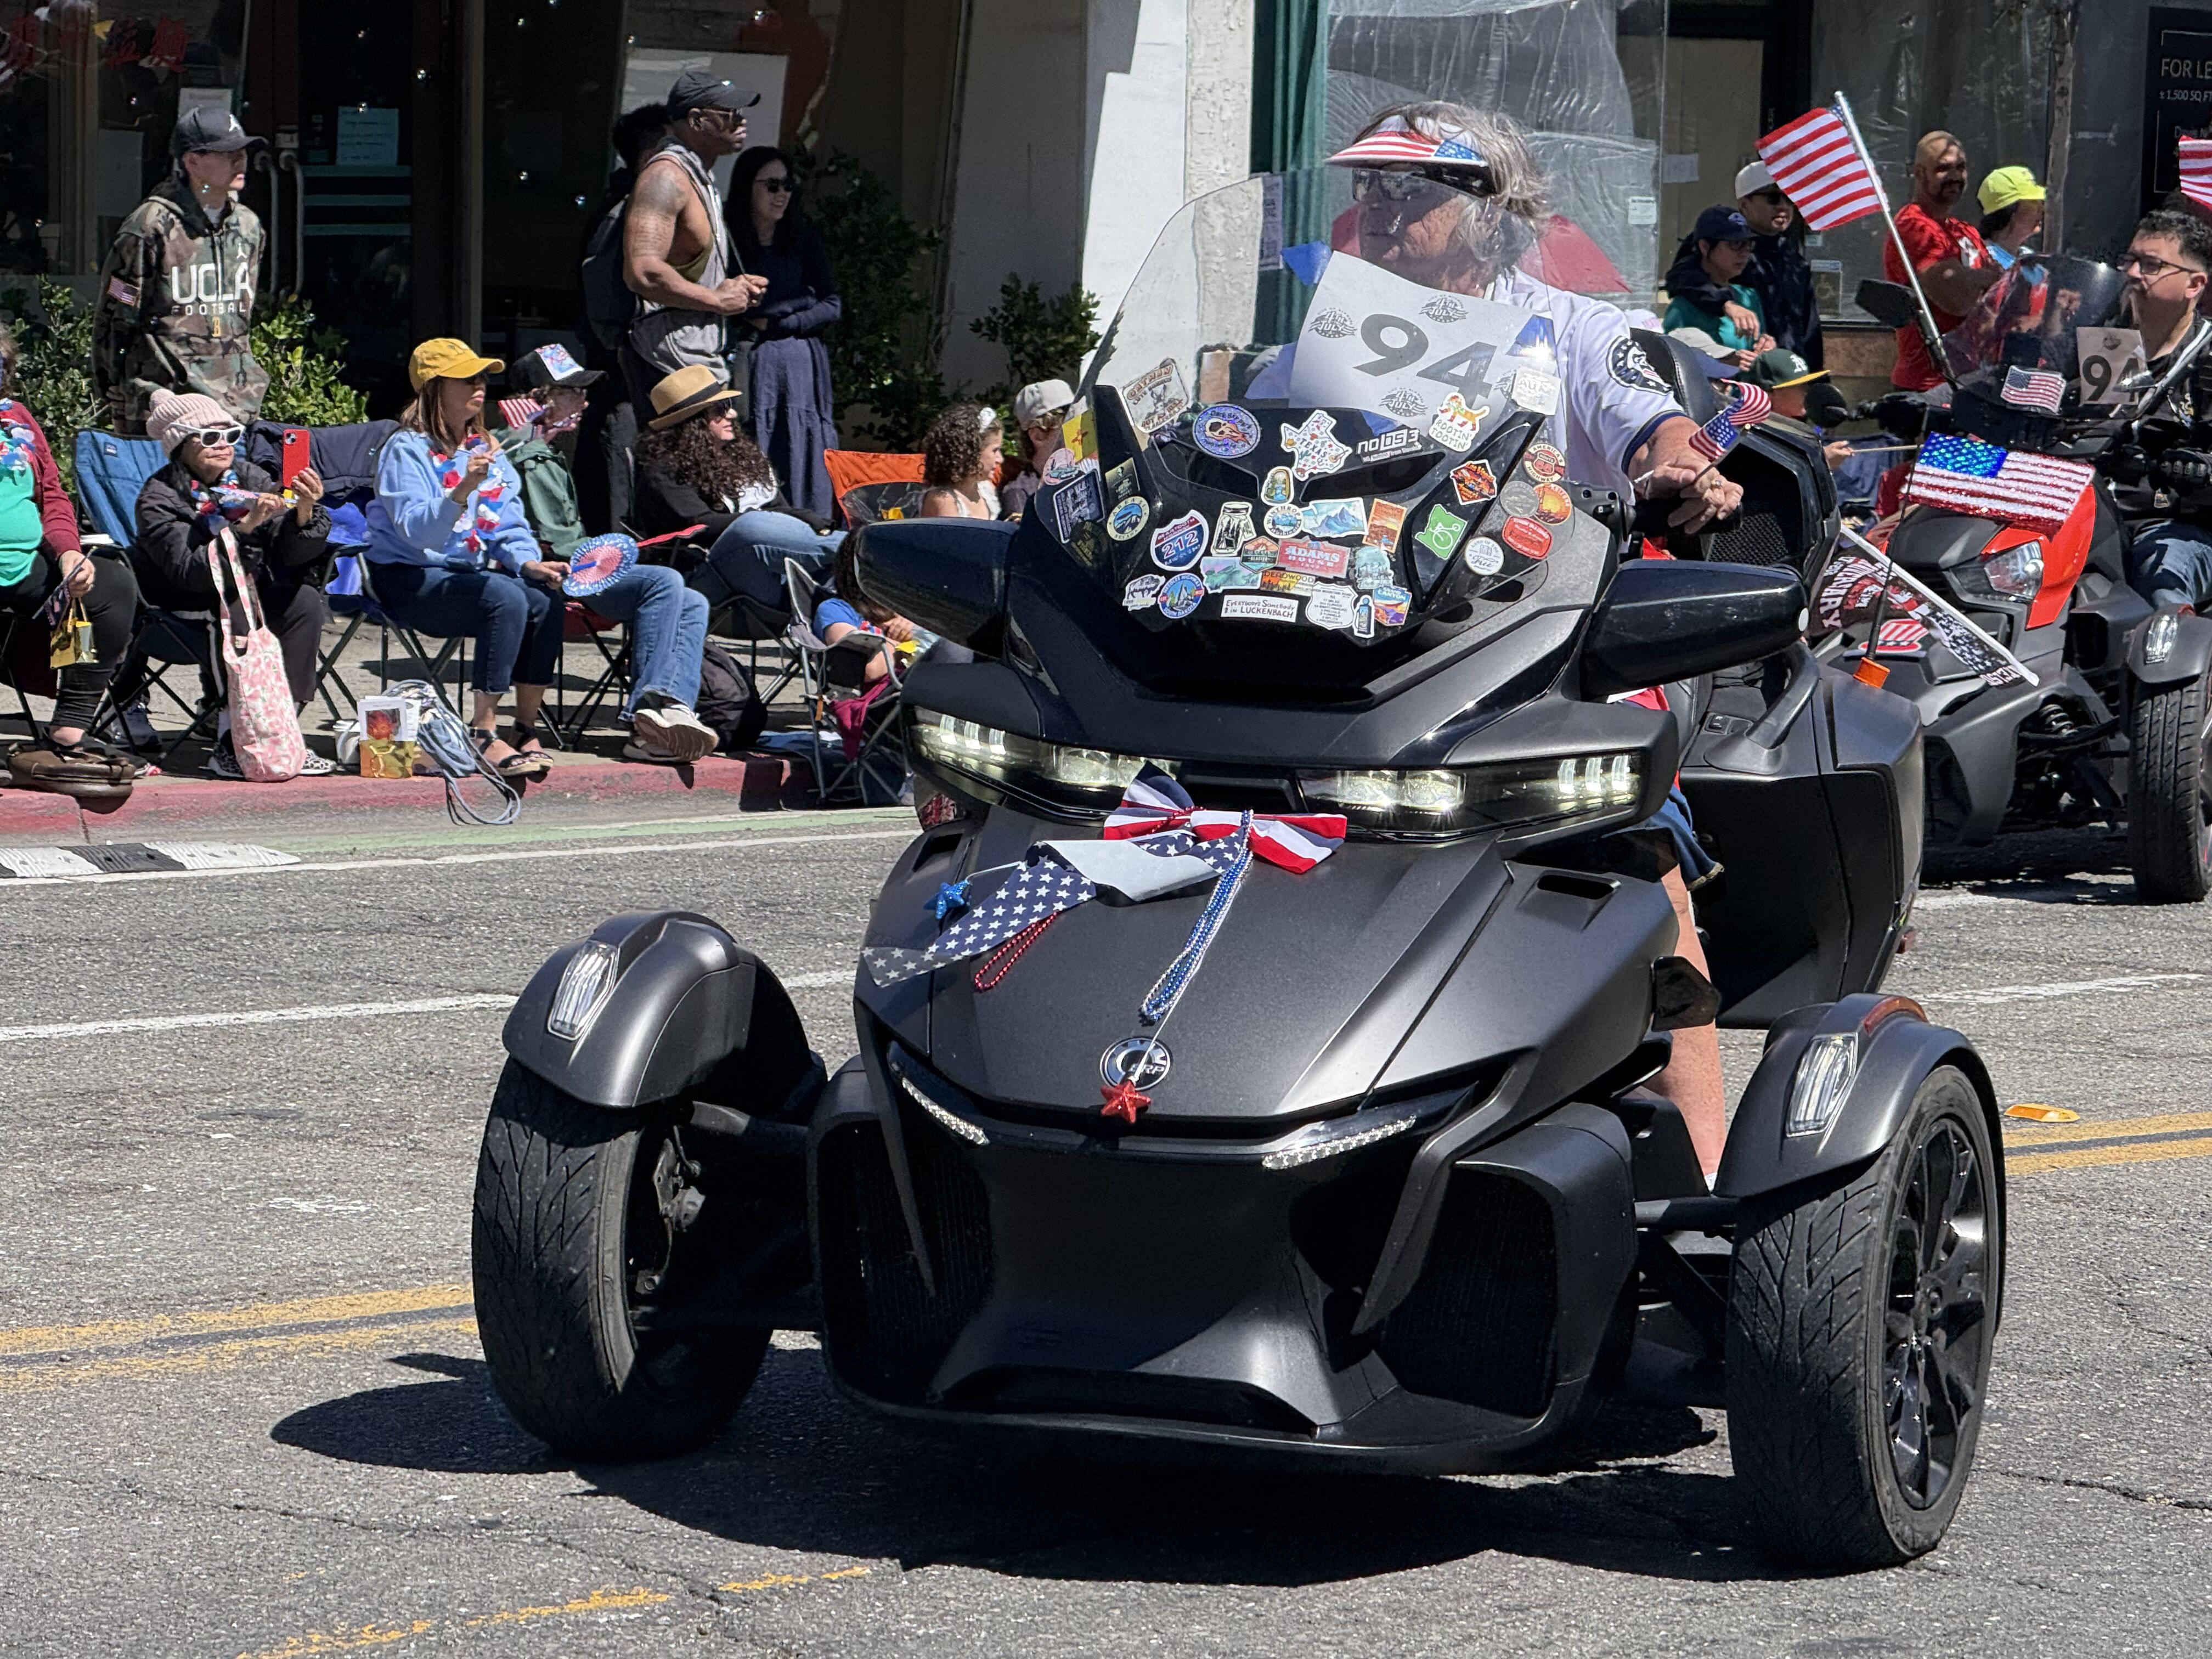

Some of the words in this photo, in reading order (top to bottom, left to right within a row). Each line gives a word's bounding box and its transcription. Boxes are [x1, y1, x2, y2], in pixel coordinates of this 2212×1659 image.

[2161, 58, 2193, 78] FOR
[2190, 92, 2202, 103] SQ
[172, 262, 253, 304] UCLA
[1428, 307, 1457, 317] JULY
[1317, 320, 1345, 331] JULY
[1353, 314, 1497, 408] 94
[2082, 355, 2140, 403] 94
[1388, 399, 1416, 410] JULY
[1435, 419, 1472, 440] ROOTIN'
[1431, 427, 1469, 450] TOOTIN'
[1299, 438, 1328, 458] TEXAS
[1527, 466, 1554, 482] HIGHWAY
[1534, 460, 1553, 473] 66
[1266, 505, 1301, 525] WINTHROP
[1161, 530, 1199, 560] 212
[1471, 539, 1484, 548] LAND
[1285, 545, 1340, 563] ADAMS
[1288, 555, 1334, 568] HOUSE
[1263, 571, 1314, 583] DEADWOOD
[1377, 589, 1407, 600] CANYON
[1163, 607, 1177, 616] SOUTH
[1177, 602, 1198, 617] DAKOTA
[1240, 606, 1294, 619] LUCKENBACH
